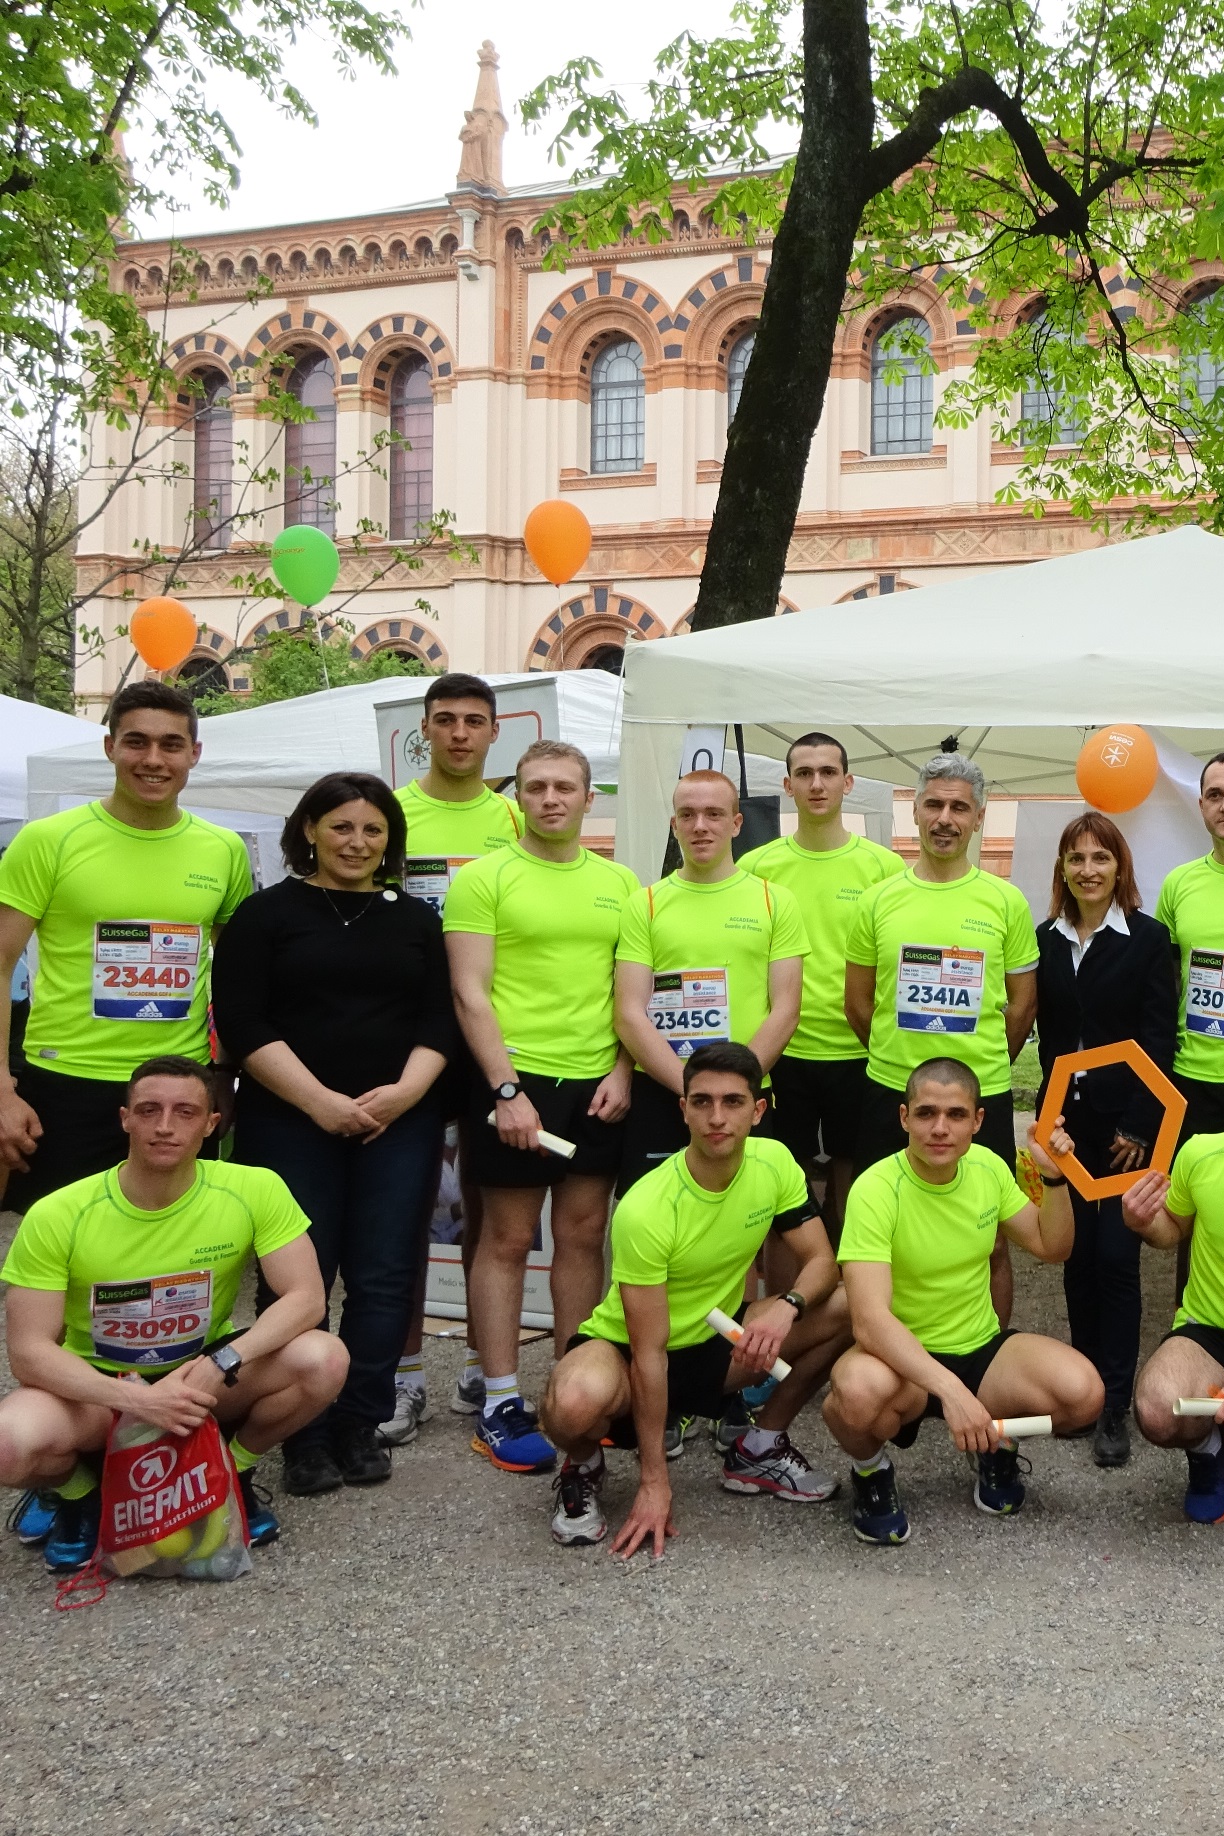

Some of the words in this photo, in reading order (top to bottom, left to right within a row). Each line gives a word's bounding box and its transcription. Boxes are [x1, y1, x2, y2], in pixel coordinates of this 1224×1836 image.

[102, 928, 148, 936] SuisseGas
[905, 952, 940, 961] SuisseGas
[1193, 956, 1221, 965] SuisseGas
[104, 966, 190, 988] 2344D
[908, 985, 970, 1006] 2341A
[654, 1009, 721, 1029] 2345C
[195, 1242, 234, 1255] ACCADEMIA
[98, 1288, 148, 1300] SuisseGas
[102, 1314, 200, 1339] 2309D
